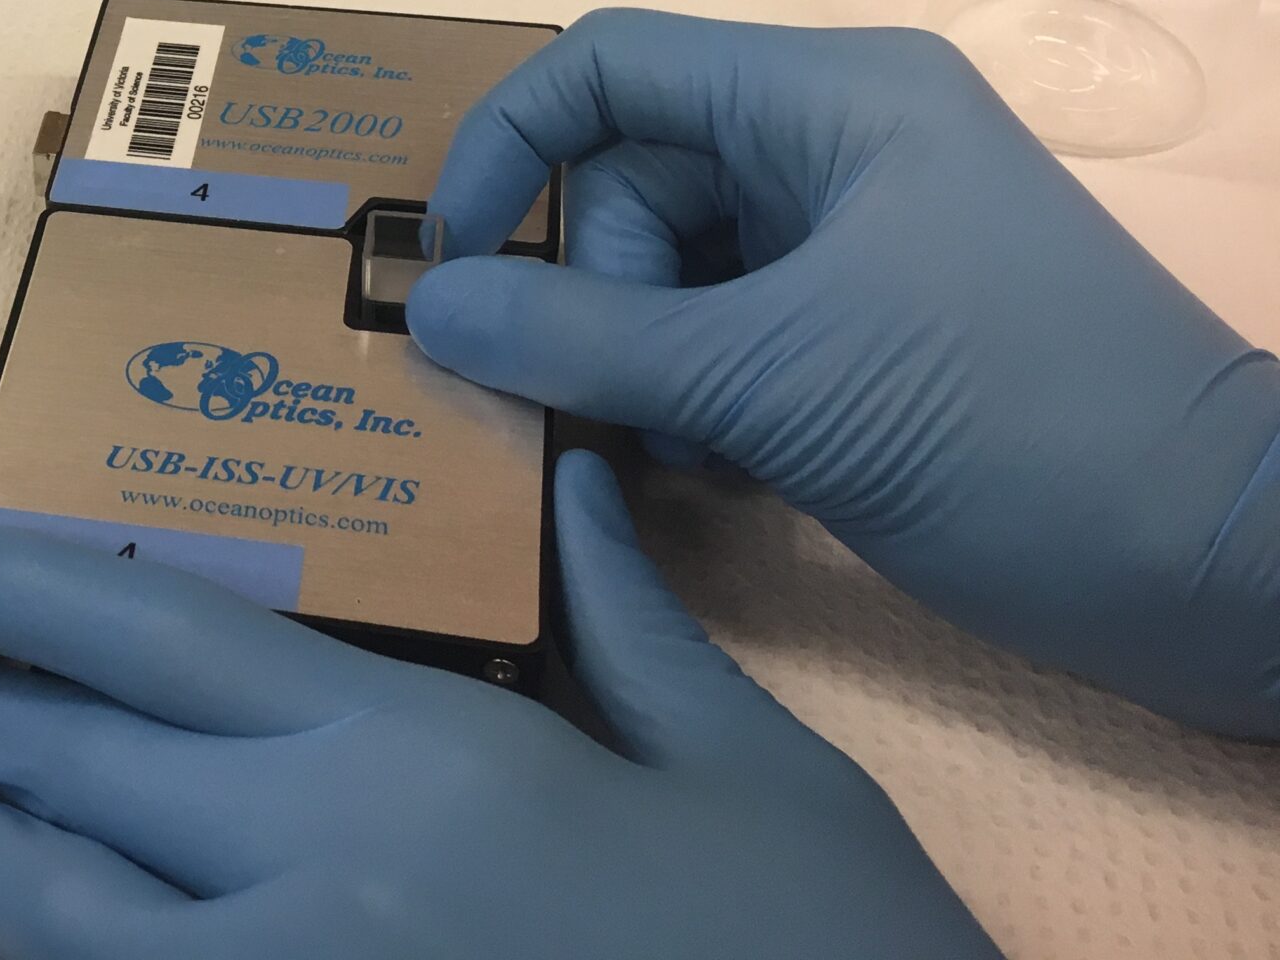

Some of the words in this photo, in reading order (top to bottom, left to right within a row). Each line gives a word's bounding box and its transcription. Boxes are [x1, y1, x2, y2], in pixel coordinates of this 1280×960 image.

[296, 38, 373, 66] Ocean
[373, 67, 413, 82] Inc.
[100, 98, 122, 131] University
[113, 66, 130, 90] Victoria
[118, 104, 136, 127] Faculty
[128, 71, 144, 96] Science
[186, 85, 209, 121] 00216
[219, 100, 405, 141] USB2000
[189, 182, 210, 202] 4
[234, 351, 357, 405] Ocean
[199, 380, 344, 432] Optics,
[353, 409, 423, 438] Inc.
[105, 444, 422, 506] USB-ISS-UV/VIS
[120, 488, 390, 536] www.oceanoptics.com
